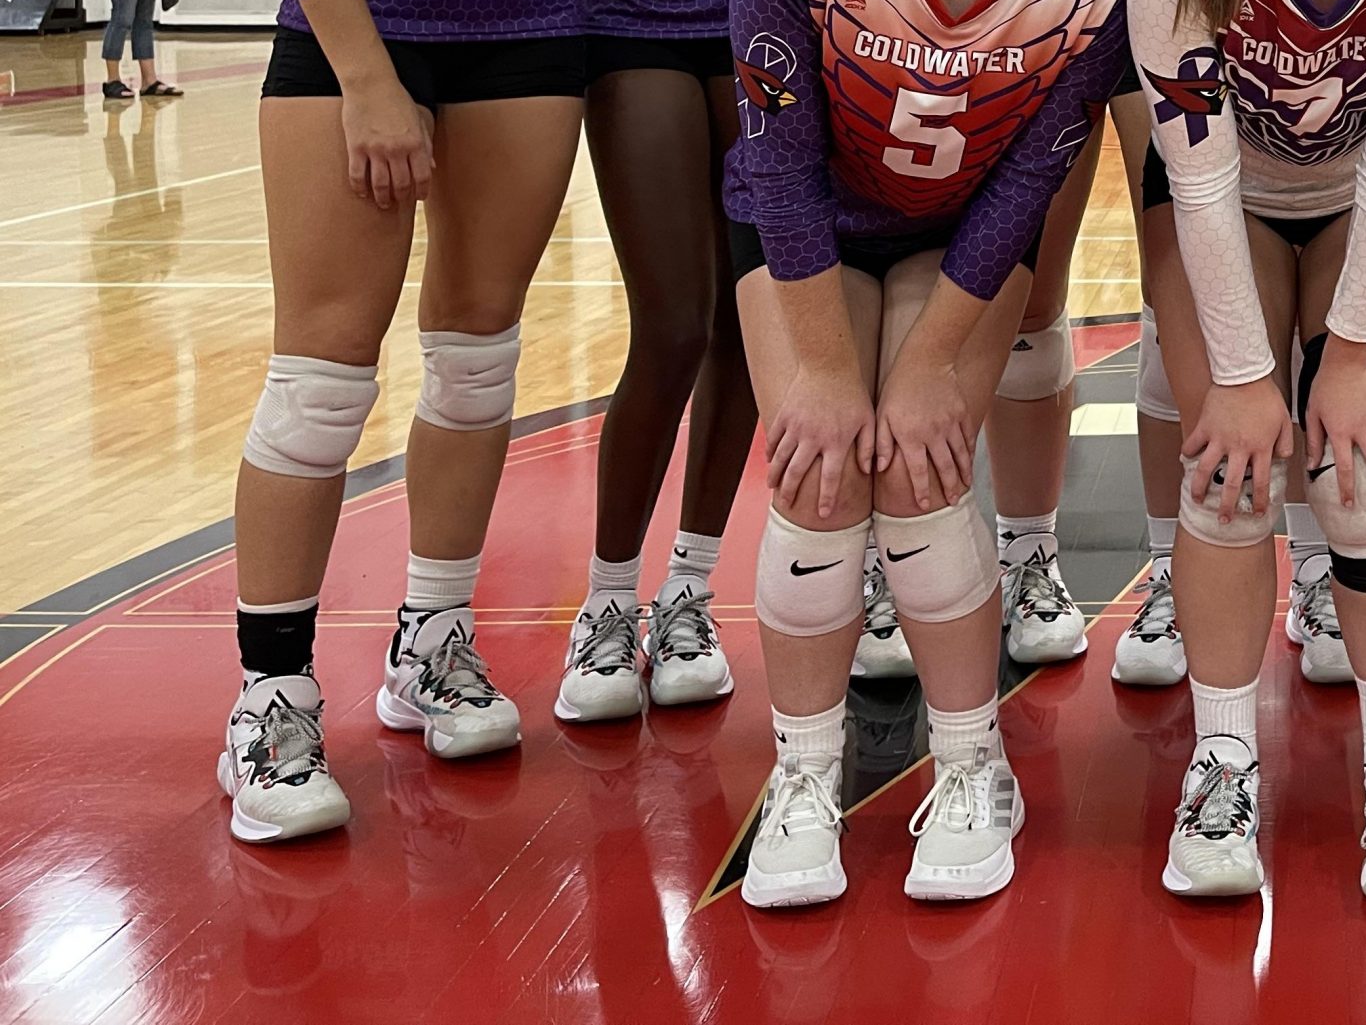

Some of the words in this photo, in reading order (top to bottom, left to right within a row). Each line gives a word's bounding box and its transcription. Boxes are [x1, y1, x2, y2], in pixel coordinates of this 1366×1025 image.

[853, 29, 1027, 78] COLDWATER
[881, 86, 969, 180] 5
[1271, 76, 1344, 137] 7
